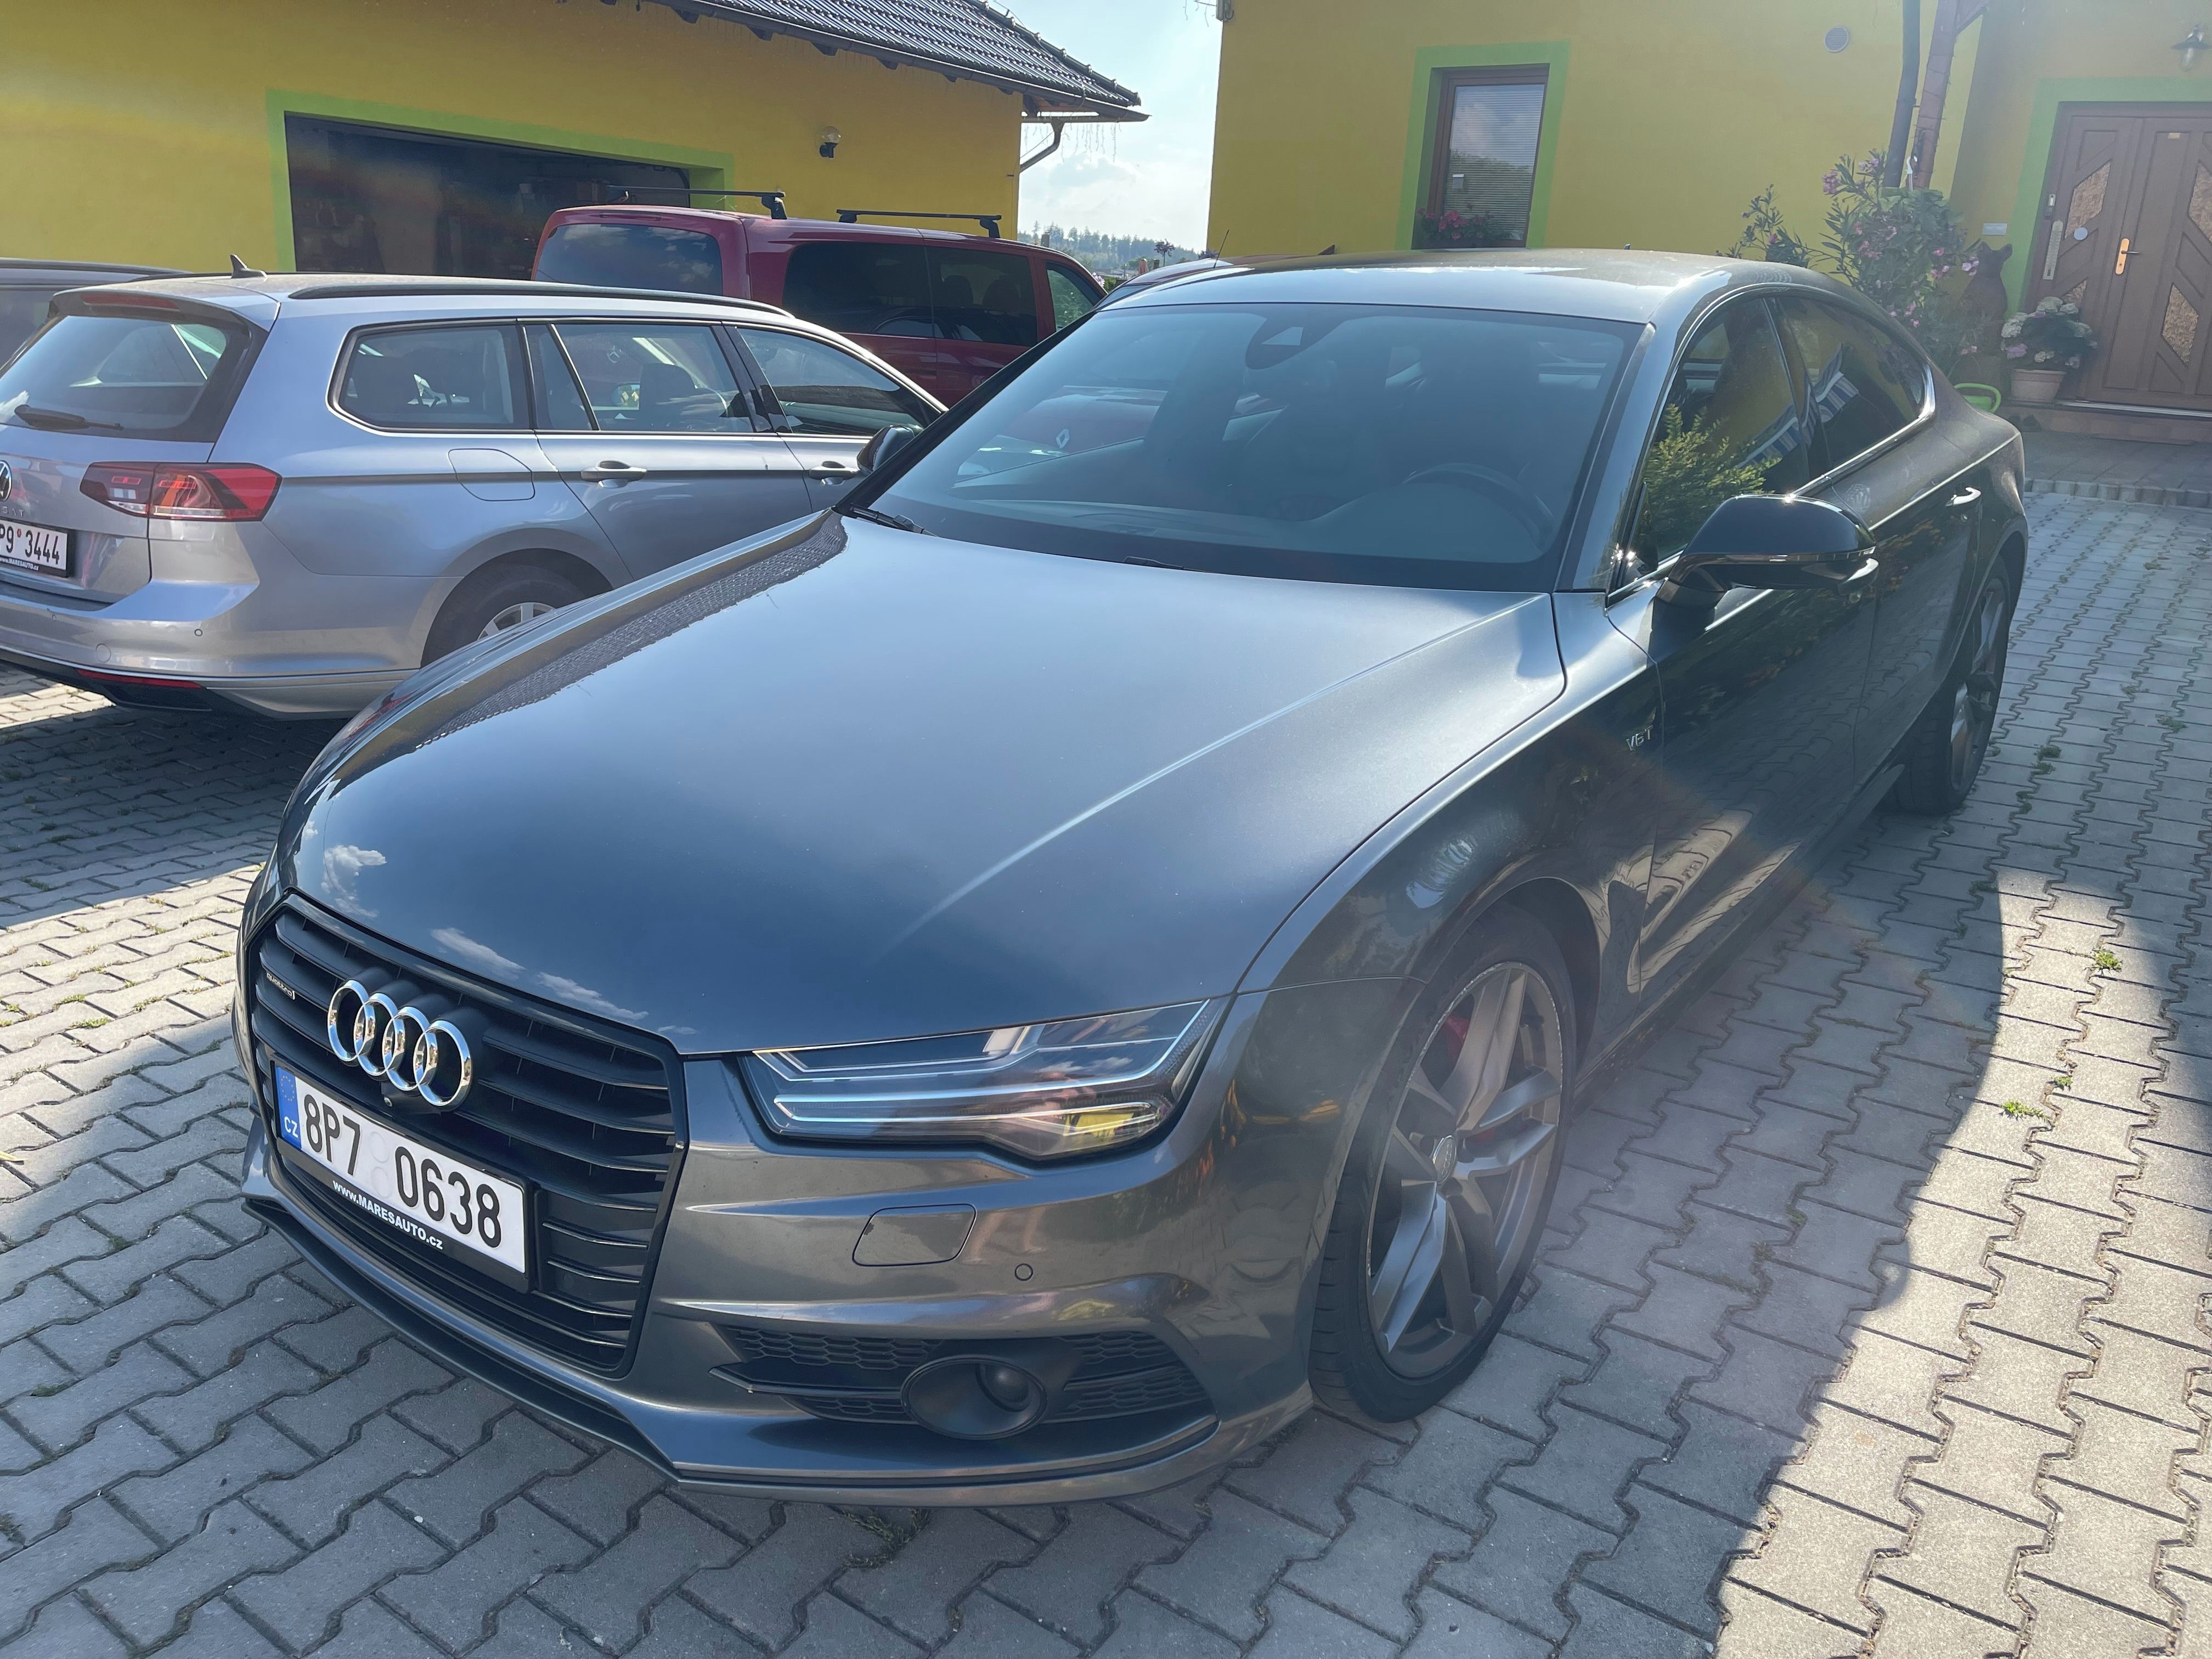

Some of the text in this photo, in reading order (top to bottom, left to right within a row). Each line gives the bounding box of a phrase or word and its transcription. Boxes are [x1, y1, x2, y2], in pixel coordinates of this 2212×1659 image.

[25, 530, 60, 565] 3444
[1626, 725, 1654, 751] V6T
[267, 973, 292, 997] quattro
[284, 1116, 298, 1138] CZ
[303, 1094, 501, 1248] 8P7 0638
[332, 1181, 443, 1250] www.MARESAUTO.cz
